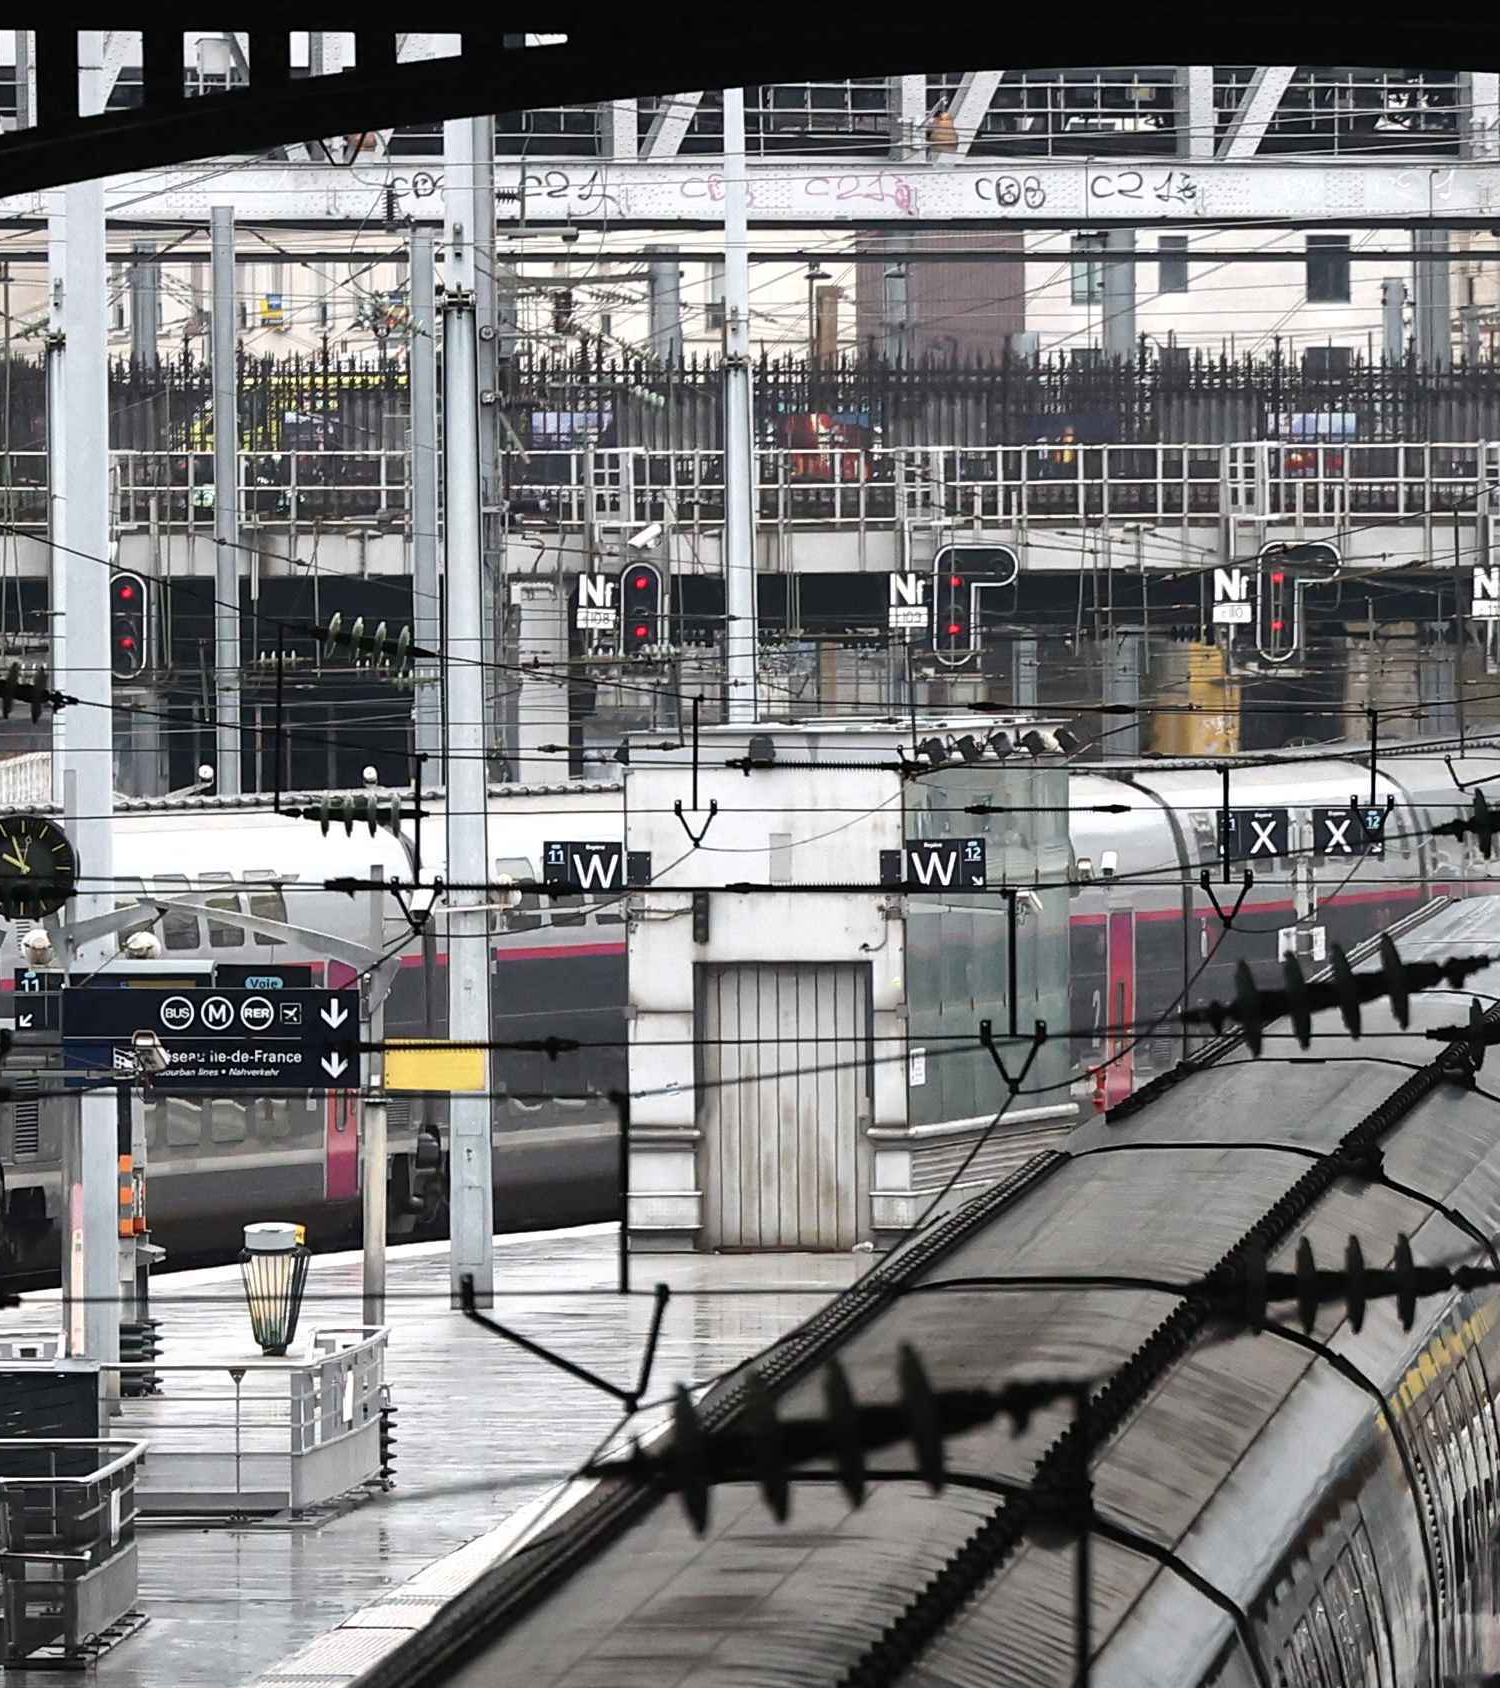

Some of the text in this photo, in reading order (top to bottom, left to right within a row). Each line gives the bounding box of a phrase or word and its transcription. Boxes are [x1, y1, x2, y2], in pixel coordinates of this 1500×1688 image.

[1366, 815, 1380, 829] 12
[1250, 820, 1277, 854] X
[1324, 820, 1352, 853] X
[548, 850, 564, 862] 11
[965, 847, 981, 859] 12
[573, 854, 619, 889] W
[911, 851, 957, 886] W
[21, 978, 40, 992] 11
[251, 976, 277, 989] Voie
[165, 1004, 270, 1023] BUS M RER
